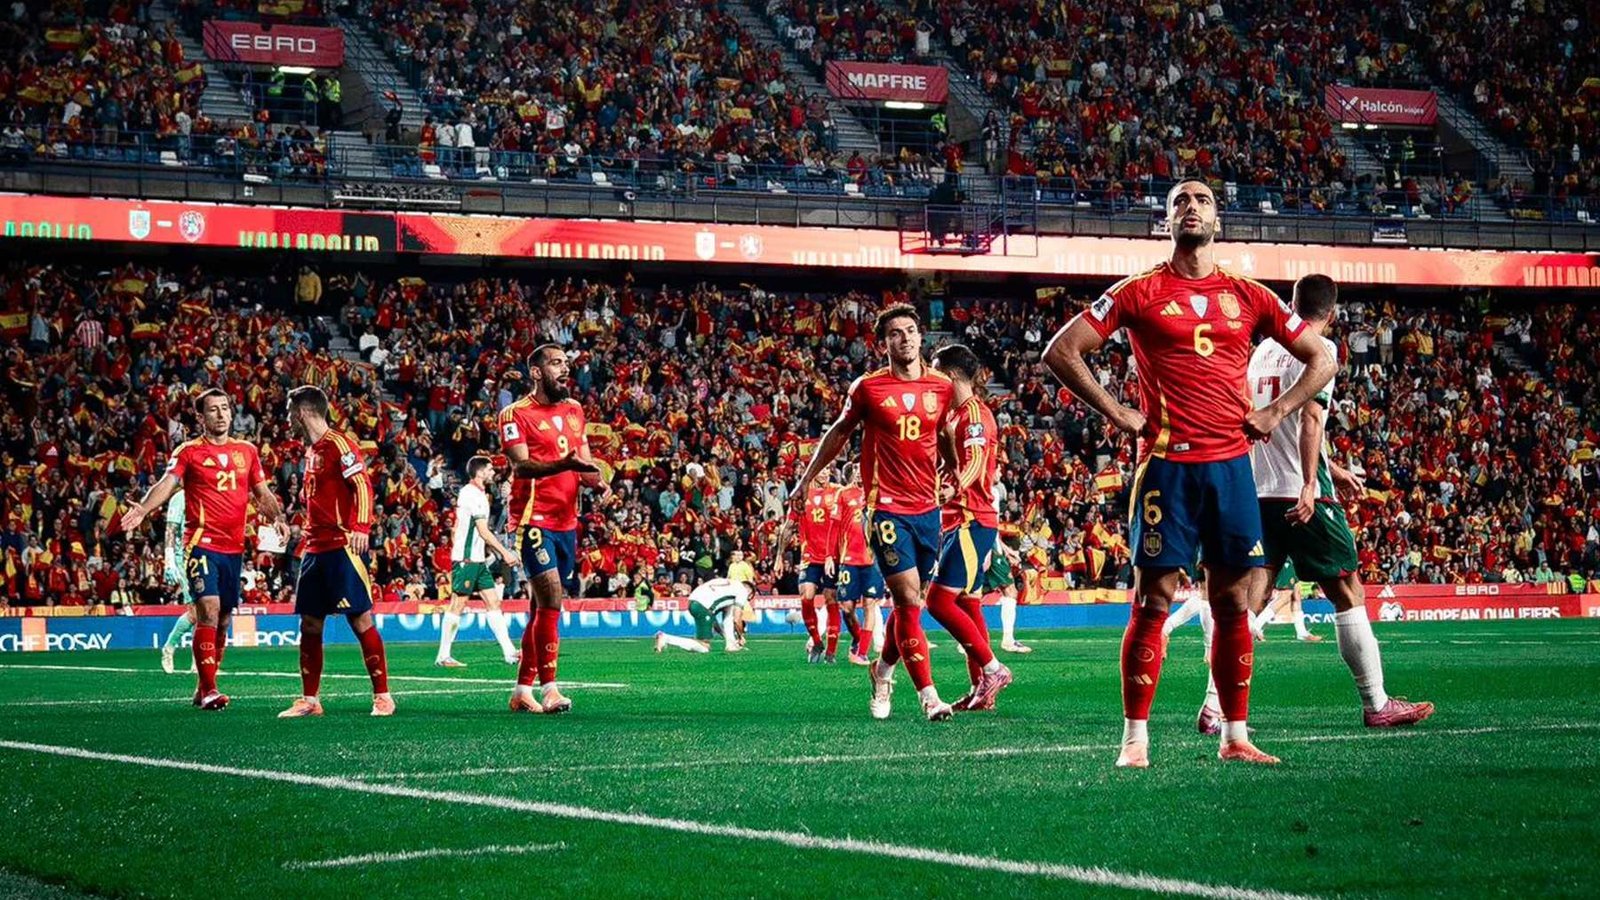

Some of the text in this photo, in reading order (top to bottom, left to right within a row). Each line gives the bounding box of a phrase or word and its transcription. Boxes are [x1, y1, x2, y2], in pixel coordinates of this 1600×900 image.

[847, 72, 927, 90] MAPFRE
[1360, 100, 1403, 113] Halcón
[1193, 324, 1215, 357] 6
[896, 415, 921, 441] 18
[557, 435, 569, 458] 9
[216, 470, 237, 492] 21
[811, 508, 825, 523] 12
[853, 508, 862, 522] 2
[1143, 490, 1162, 525] 6
[528, 527, 543, 548] 9
[189, 555, 209, 578] 21
[1406, 606, 1561, 620] EUROPEAN QUALIFIERS
[46, 633, 113, 651] POSAY
